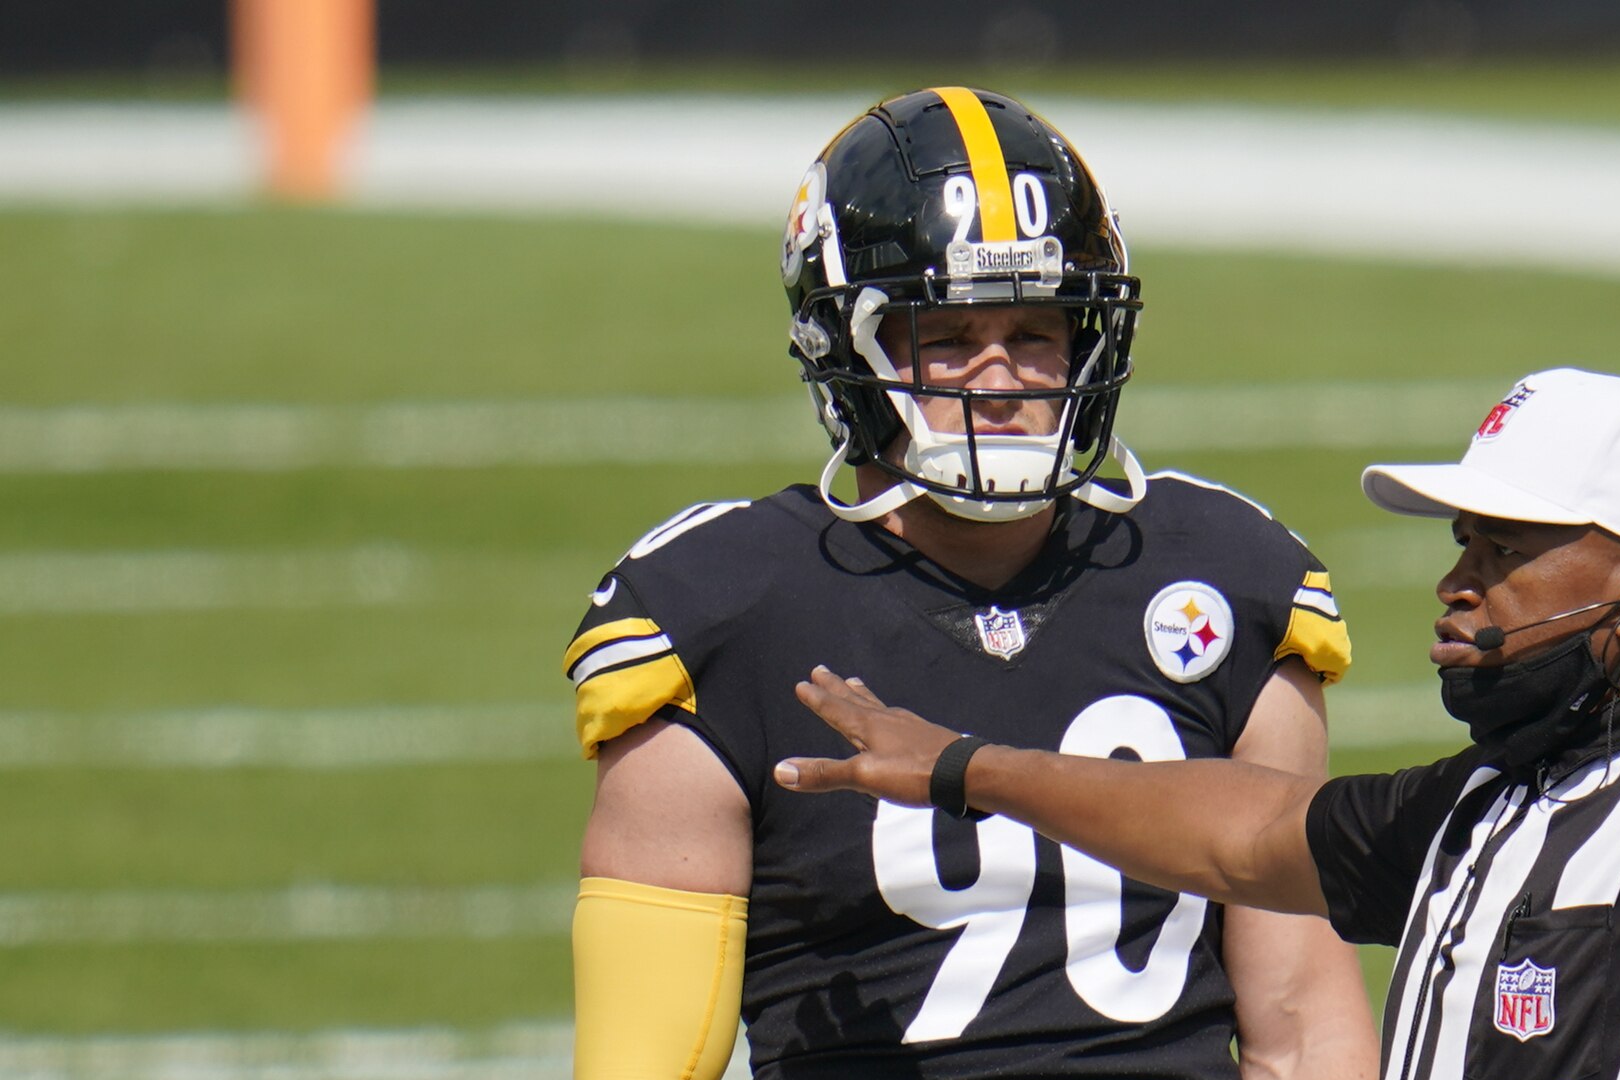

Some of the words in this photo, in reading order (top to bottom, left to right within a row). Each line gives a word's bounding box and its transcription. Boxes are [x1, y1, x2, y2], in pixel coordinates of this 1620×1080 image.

[977, 246, 1033, 268] Steelers
[1154, 620, 1187, 635] Steelers
[987, 630, 1018, 650] NFL
[1499, 994, 1549, 1032] NFL
